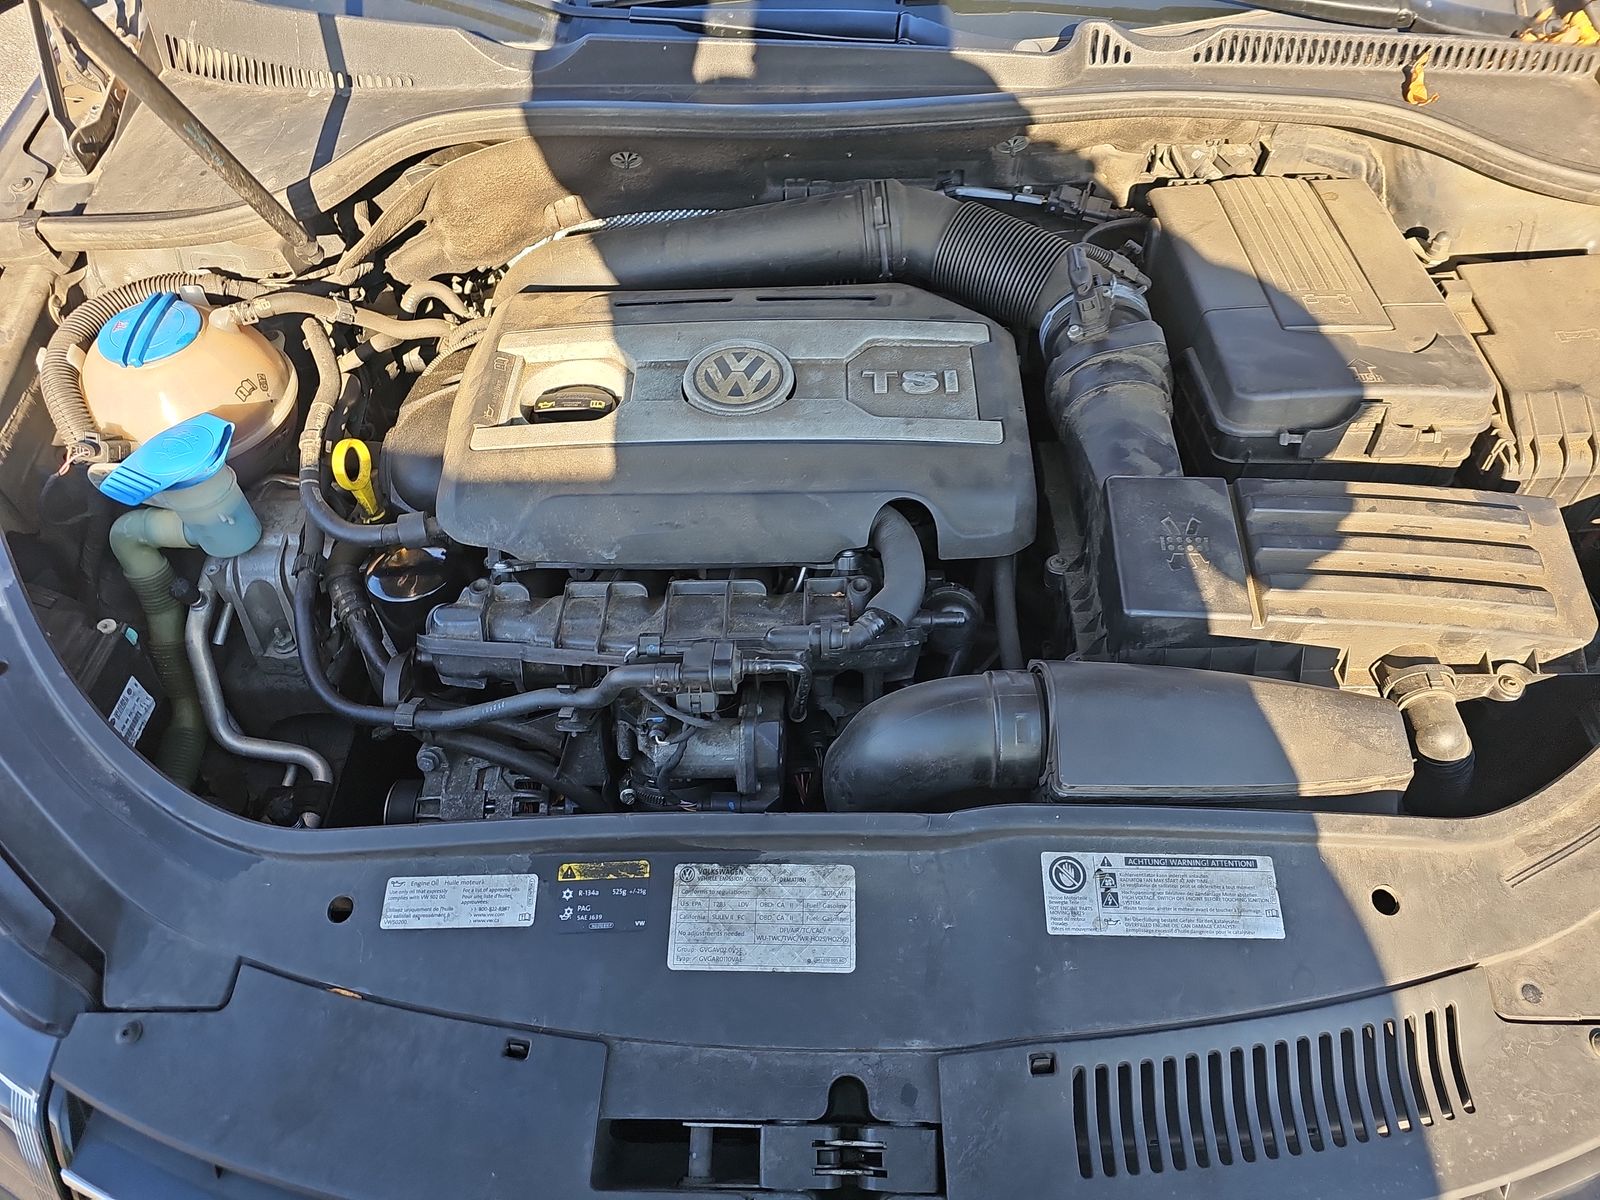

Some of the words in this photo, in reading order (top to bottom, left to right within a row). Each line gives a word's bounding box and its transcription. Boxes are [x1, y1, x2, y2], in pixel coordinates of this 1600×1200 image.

[697, 347, 779, 405] VW
[862, 369, 960, 396] TSI
[1128, 858, 1167, 866] ACHTUNG!
[1211, 860, 1255, 868] ATTENTION!
[680, 866, 695, 883] VW
[698, 868, 744, 876] VOLKSWAGEN
[411, 880, 430, 888] Engine
[612, 888, 627, 896] 525g
[629, 888, 646, 896] +/-25g
